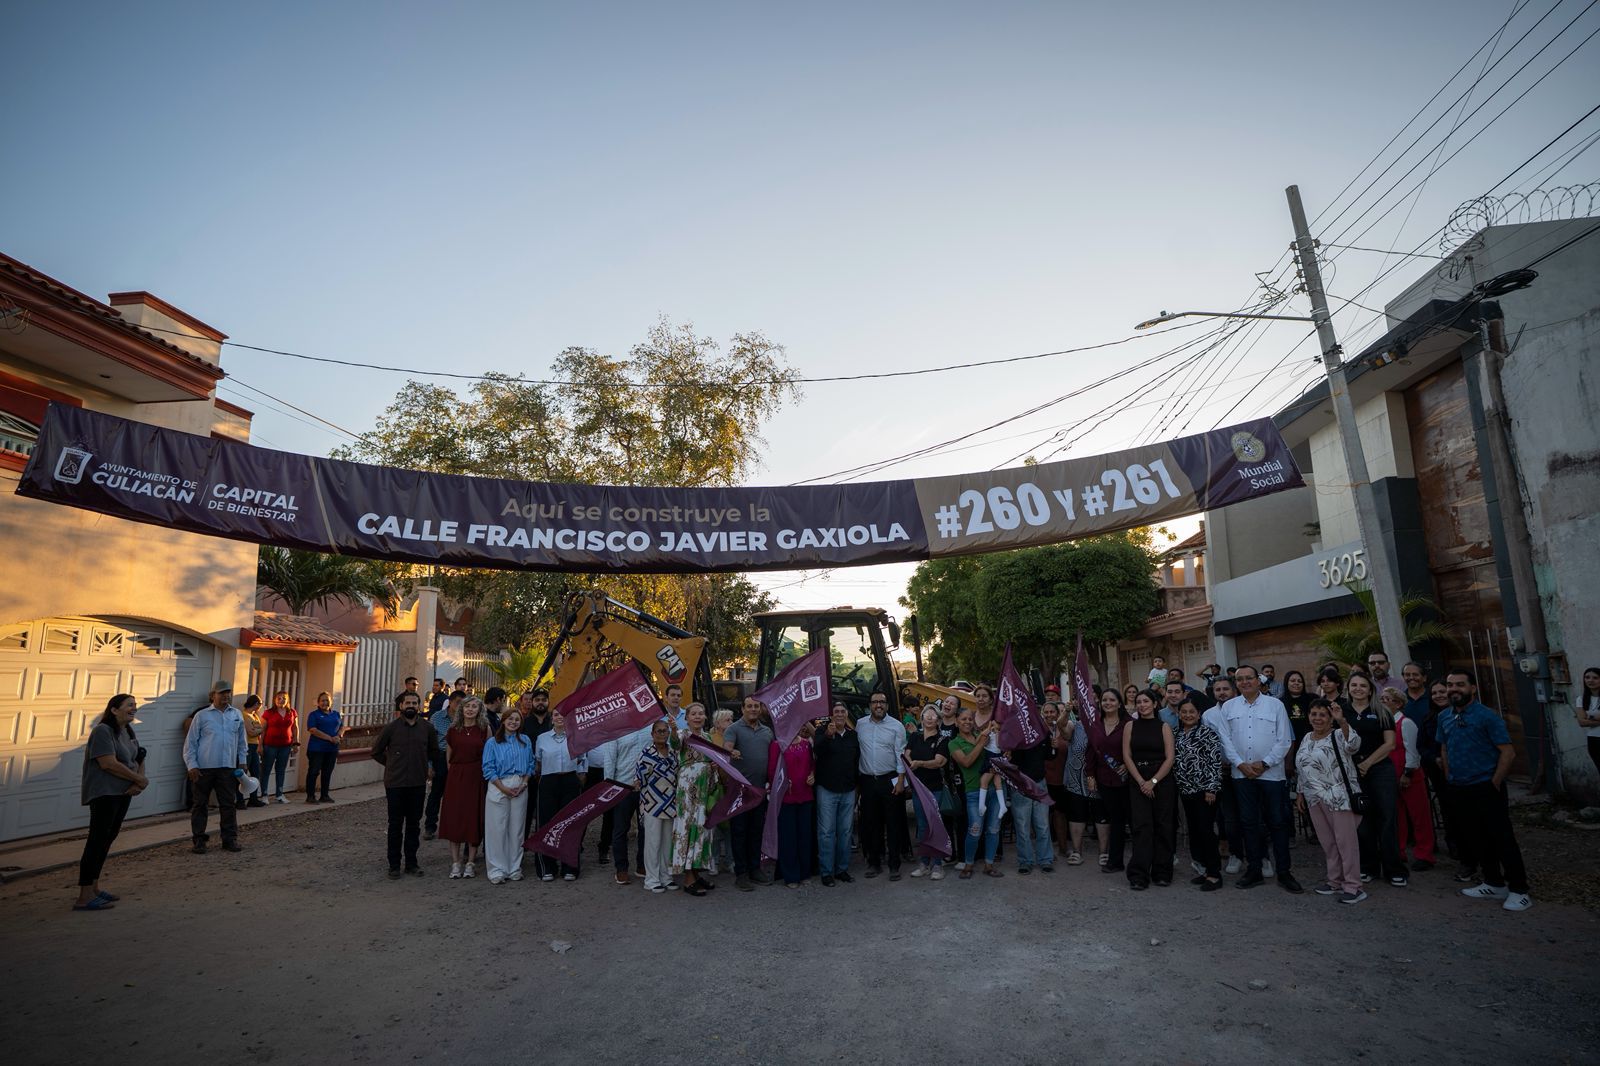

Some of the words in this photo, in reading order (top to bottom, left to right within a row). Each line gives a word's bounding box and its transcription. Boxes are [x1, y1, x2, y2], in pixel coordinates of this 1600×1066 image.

[99, 462, 180, 486] AYUNTAMIENTO
[182, 480, 198, 490] DE
[1238, 460, 1283, 479] Mundial
[1250, 473, 1285, 489] Social
[92, 471, 195, 504] CULIACÁN
[212, 483, 299, 511] CAPITAL
[935, 482, 1051, 538] #260
[1052, 487, 1076, 521] Y
[1082, 458, 1181, 516] #261
[208, 500, 224, 511] DE
[226, 502, 296, 522] BIENESTAR
[500, 498, 567, 523] Aquí
[571, 505, 601, 521] se
[608, 504, 742, 527] construye
[749, 503, 771, 522] la
[357, 512, 459, 542] CALLE
[466, 523, 651, 552] FRANCISCO
[659, 531, 768, 552] JAVIER
[776, 521, 910, 550] GAXIOLA
[1318, 549, 1366, 588] 3625
[656, 645, 686, 676] CAT
